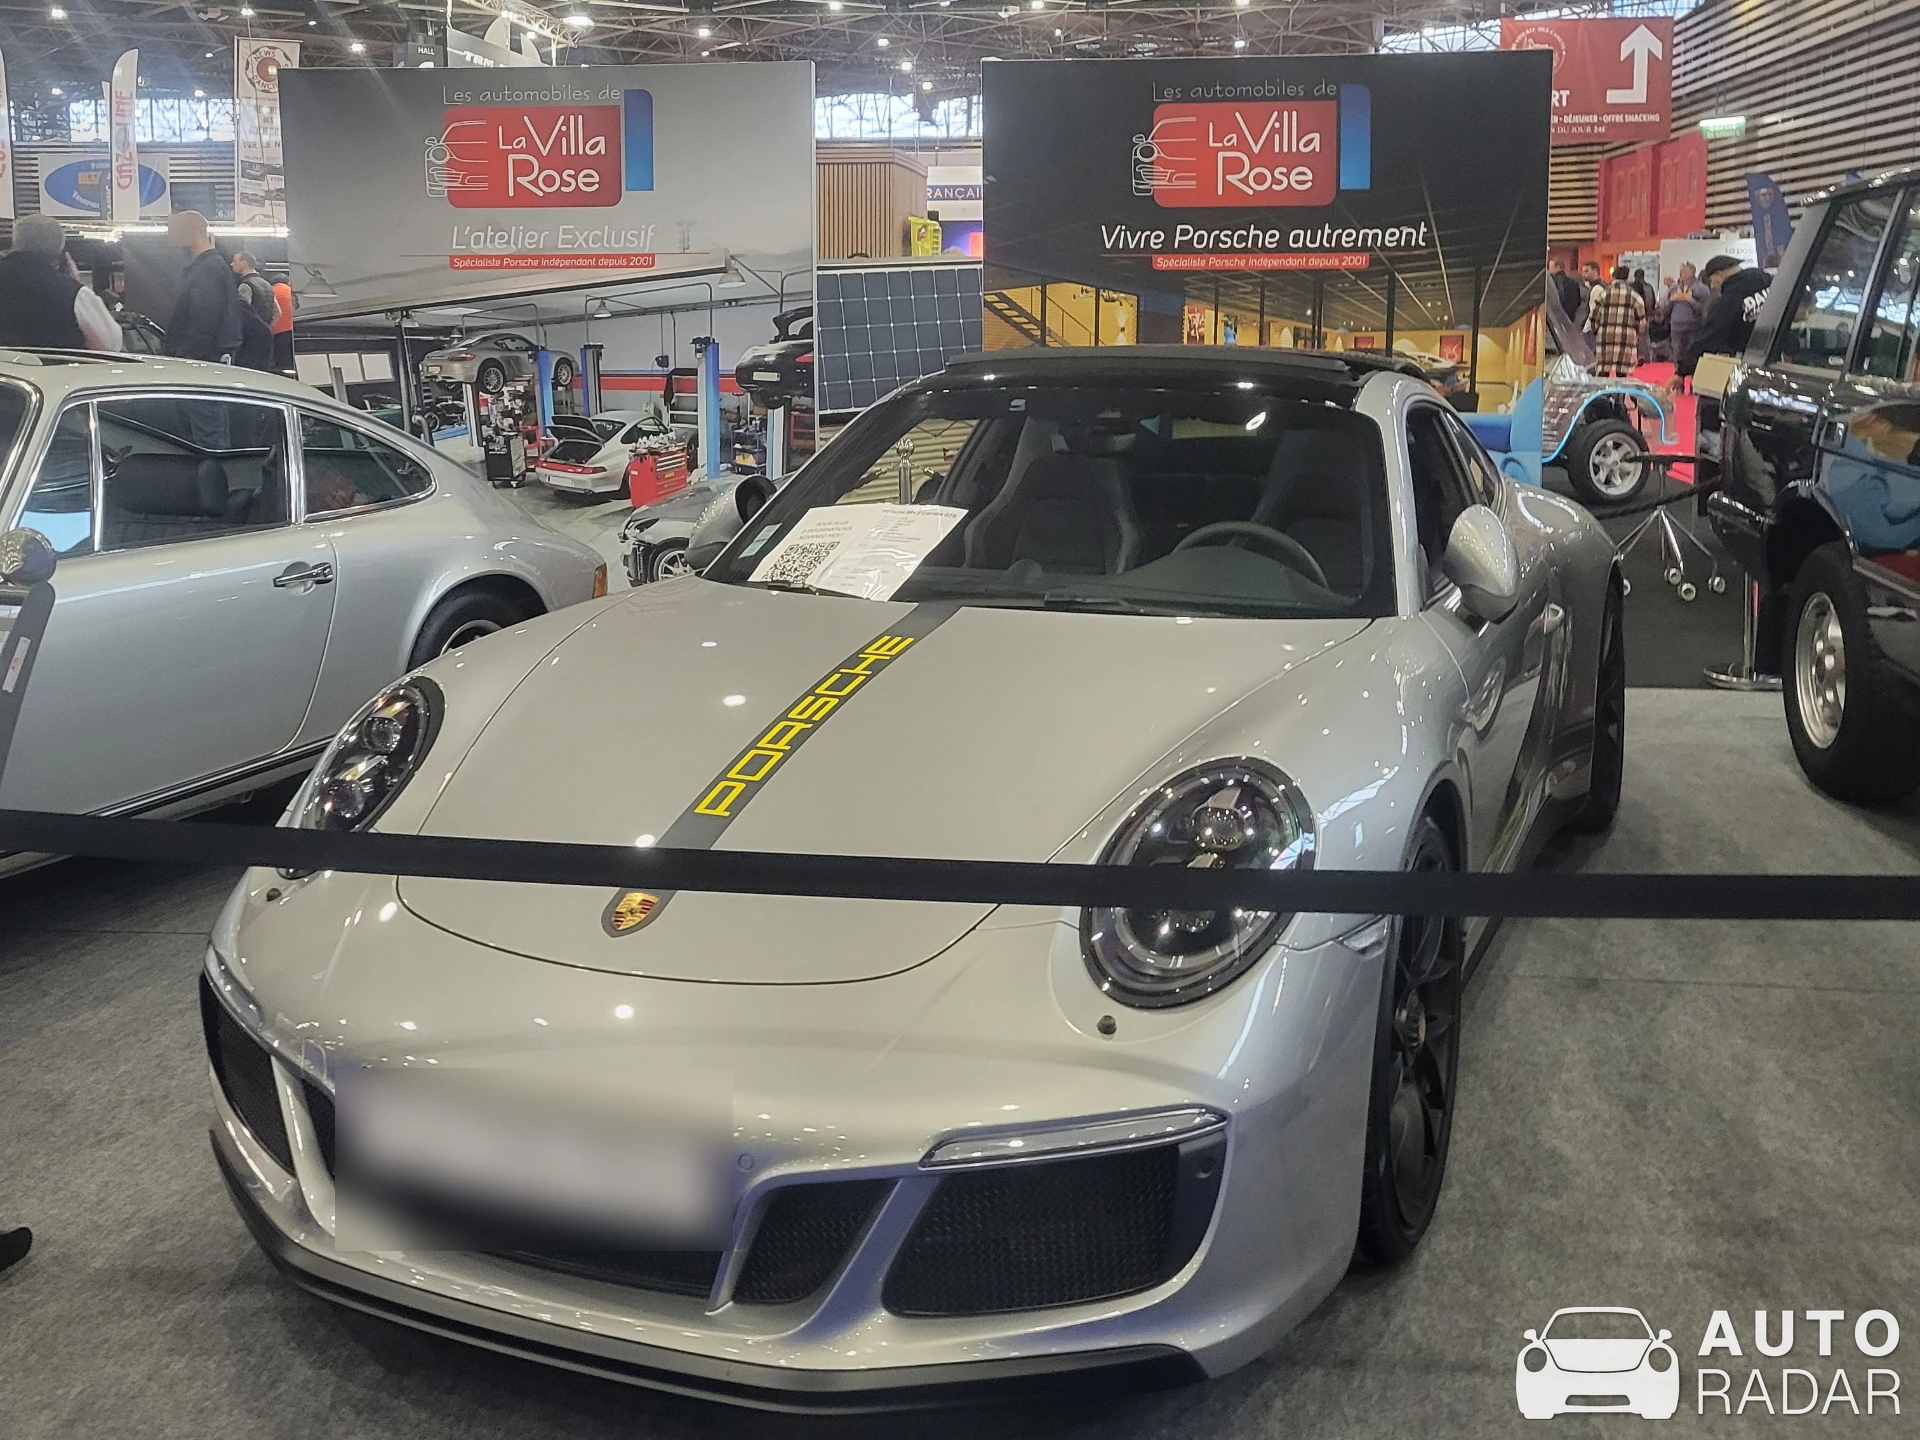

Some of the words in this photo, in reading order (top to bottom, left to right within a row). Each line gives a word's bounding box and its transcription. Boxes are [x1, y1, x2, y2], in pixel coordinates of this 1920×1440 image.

[253, 50, 276, 61] NEWS
[417, 46, 435, 55] HALL
[443, 85, 471, 105] Les
[480, 84, 590, 102] automobiles
[598, 84, 621, 100] de
[1152, 81, 1182, 102] Les
[1190, 79, 1305, 99] automobiles
[1313, 78, 1338, 96] de
[498, 125, 526, 149] La
[523, 114, 606, 157] Villa
[1208, 121, 1238, 147] La
[1235, 110, 1321, 154] Villa
[507, 153, 600, 197] Rose
[1217, 151, 1314, 196] Rose
[926, 187, 983, 200] RANÇAI
[452, 225, 550, 250] L'atelier
[557, 224, 656, 252] Exclusif
[1101, 224, 1165, 249] Vivre
[1174, 223, 1280, 249] Porsche
[1289, 221, 1428, 249] autrement
[453, 258, 501, 268] Spécialiste
[503, 258, 539, 267] Porsche
[598, 257, 628, 268] depuis
[629, 256, 652, 266] 2001
[1156, 257, 1206, 268] Spécialiste
[1208, 257, 1246, 267] Porsche
[1308, 256, 1339, 267] depuis
[1341, 255, 1366, 266] 2001
[693, 635, 915, 817] PORSCHE
